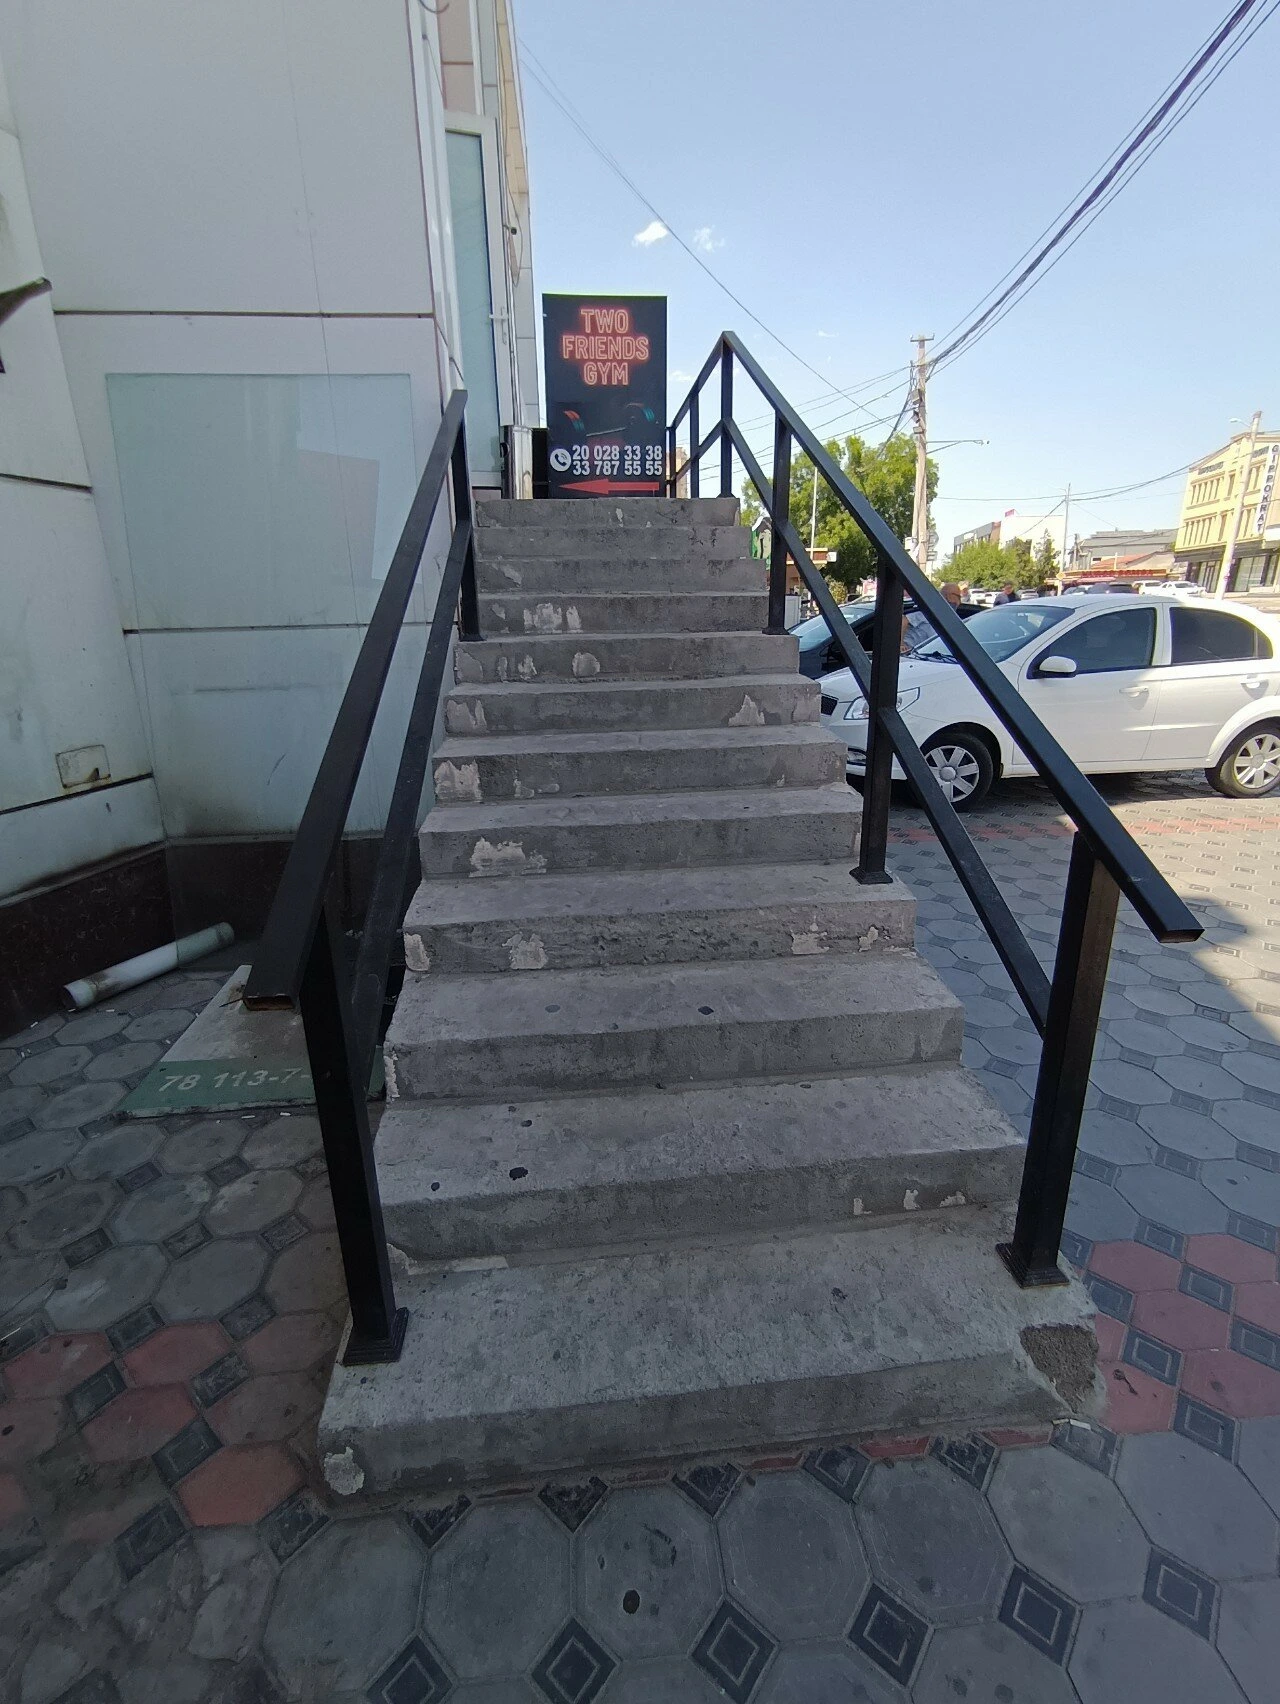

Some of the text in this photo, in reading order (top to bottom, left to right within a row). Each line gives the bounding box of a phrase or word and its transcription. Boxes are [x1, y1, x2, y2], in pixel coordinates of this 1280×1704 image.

[580, 308, 629, 334] TWO
[562, 335, 650, 361] FRIENDS
[583, 362, 629, 386] GYM
[572, 445, 663, 461] 20 028 33 38
[572, 460, 663, 476] 33 787 55 55
[1256, 444, 1279, 533] GIPPOKRAT
[159, 1068, 314, 1092] 78 113-7-
